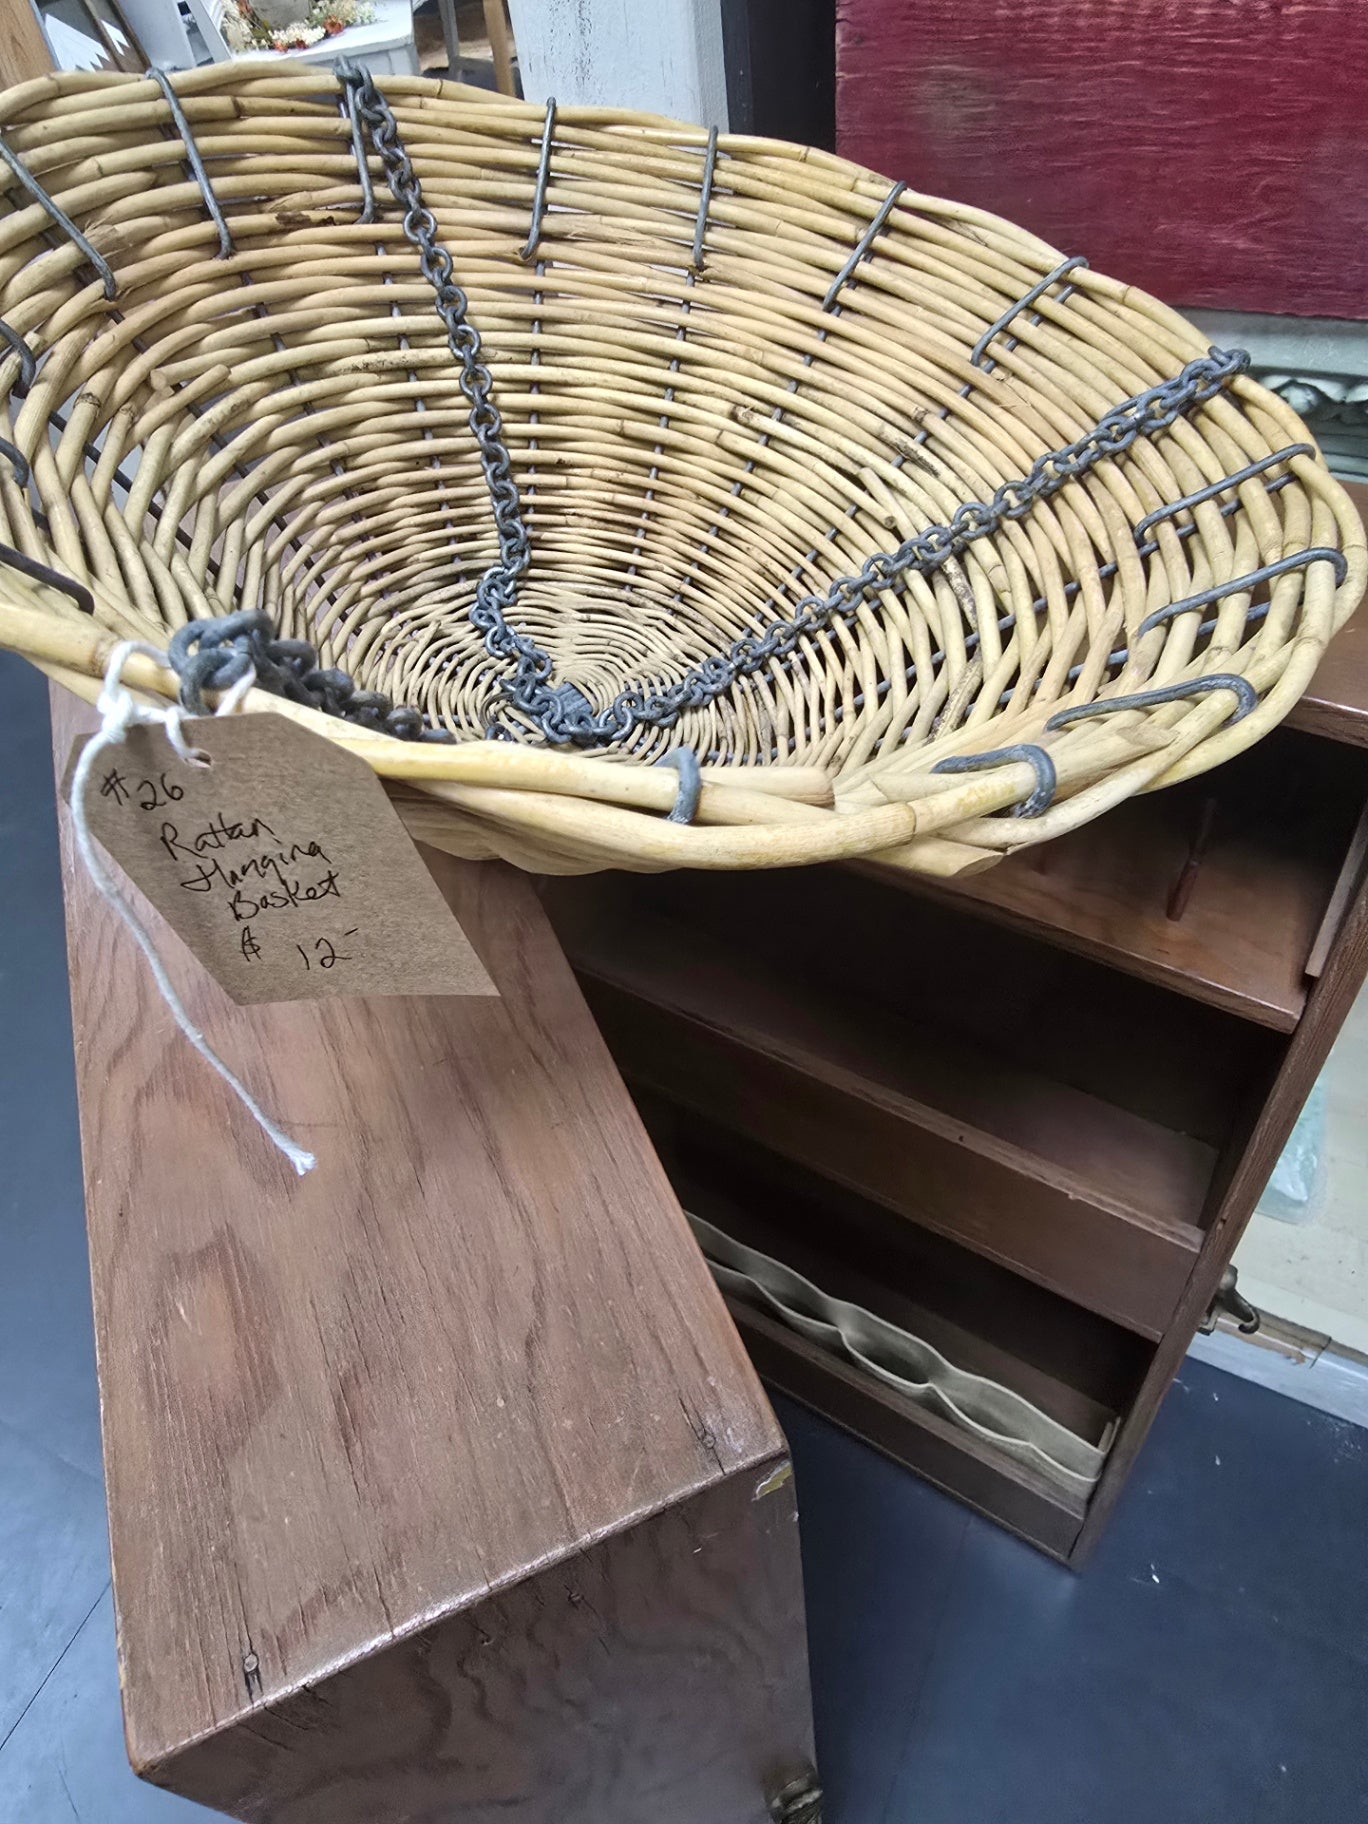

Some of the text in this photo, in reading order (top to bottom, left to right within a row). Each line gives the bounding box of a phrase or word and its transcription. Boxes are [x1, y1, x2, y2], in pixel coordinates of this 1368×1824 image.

[160, 813, 281, 861] Rattan
[180, 840, 332, 892] Hanging
[228, 870, 341, 921] Basket
